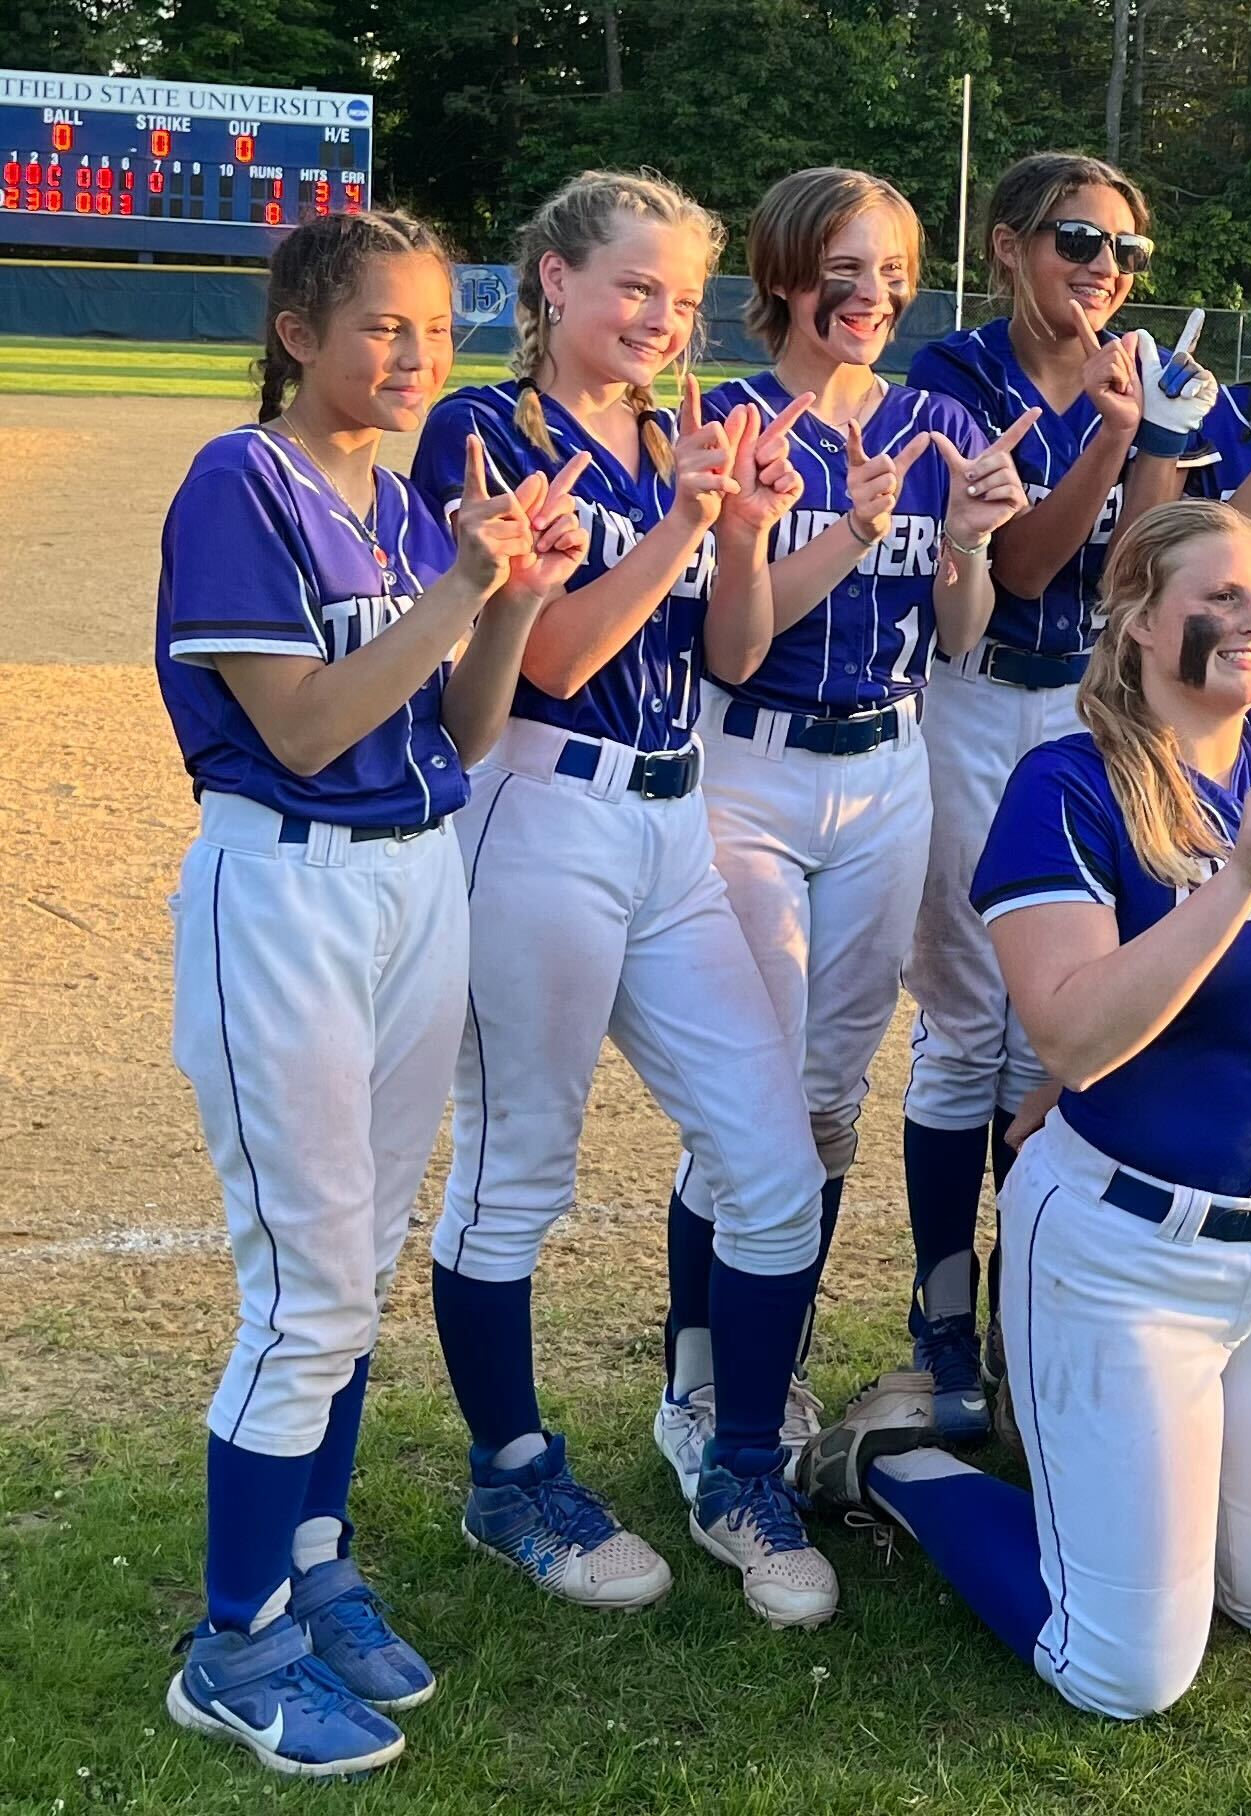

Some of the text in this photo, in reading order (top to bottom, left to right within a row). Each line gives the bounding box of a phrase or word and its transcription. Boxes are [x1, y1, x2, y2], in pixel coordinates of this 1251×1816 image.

[0, 77, 92, 101] TFIELD
[101, 83, 179, 108] STATE
[189, 90, 346, 118] UNIVERSITY
[43, 107, 350, 143] BALL STRIKE OUT H/E
[53, 124, 255, 163] 0 0 0
[10, 150, 18, 162] 1
[30, 151, 39, 164] 2
[50, 152, 59, 165] 3
[81, 154, 89, 167] 4
[101, 155, 110, 168] 5
[153, 160, 161, 172] 7
[173, 161, 181, 174] 8
[192, 162, 201, 175] 9
[219, 164, 234, 177] 10
[249, 165, 283, 179] RUNS
[300, 168, 328, 182] HITS
[341, 171, 365, 184] ERR
[5, 187, 20, 208] 2
[26, 188, 41, 211] 3
[46, 190, 62, 212] 0
[76, 192, 92, 213] 0
[96, 192, 112, 215] 0
[273, 180, 283, 199] 1
[315, 181, 330, 203] 3
[345, 184, 360, 203] 4
[460, 278, 500, 314] 15
